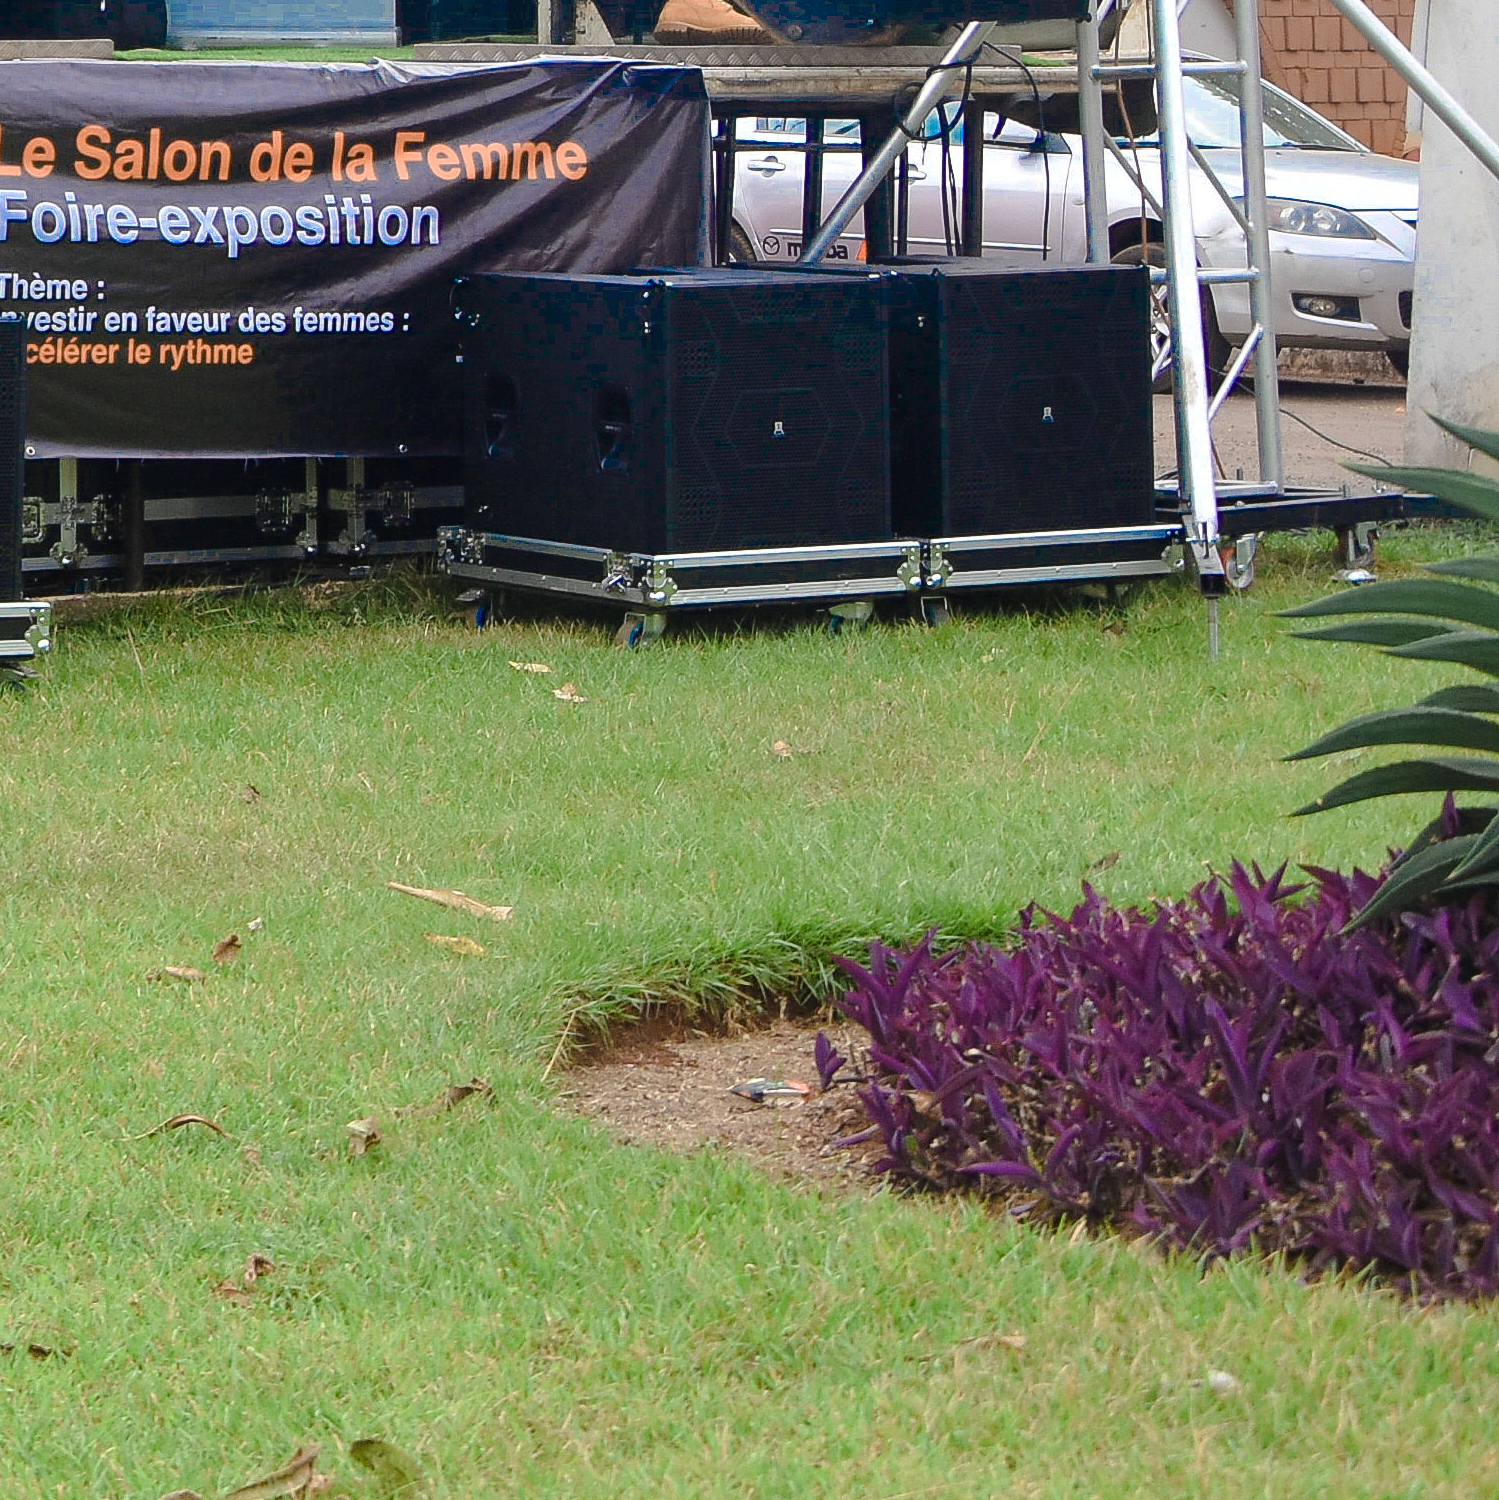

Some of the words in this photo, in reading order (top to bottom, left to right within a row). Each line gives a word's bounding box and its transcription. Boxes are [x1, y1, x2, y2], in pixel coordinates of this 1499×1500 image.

[74, 124, 232, 182] Salon
[249, 129, 315, 183] de
[331, 131, 378, 183] la
[394, 131, 588, 182] Femme
[787, 242, 849, 260] mda
[104, 311, 138, 333] en
[145, 306, 231, 333] faveur
[238, 306, 287, 333] des
[292, 306, 395, 333] femmes
[127, 337, 152, 365] le
[159, 337, 253, 372] rythme
